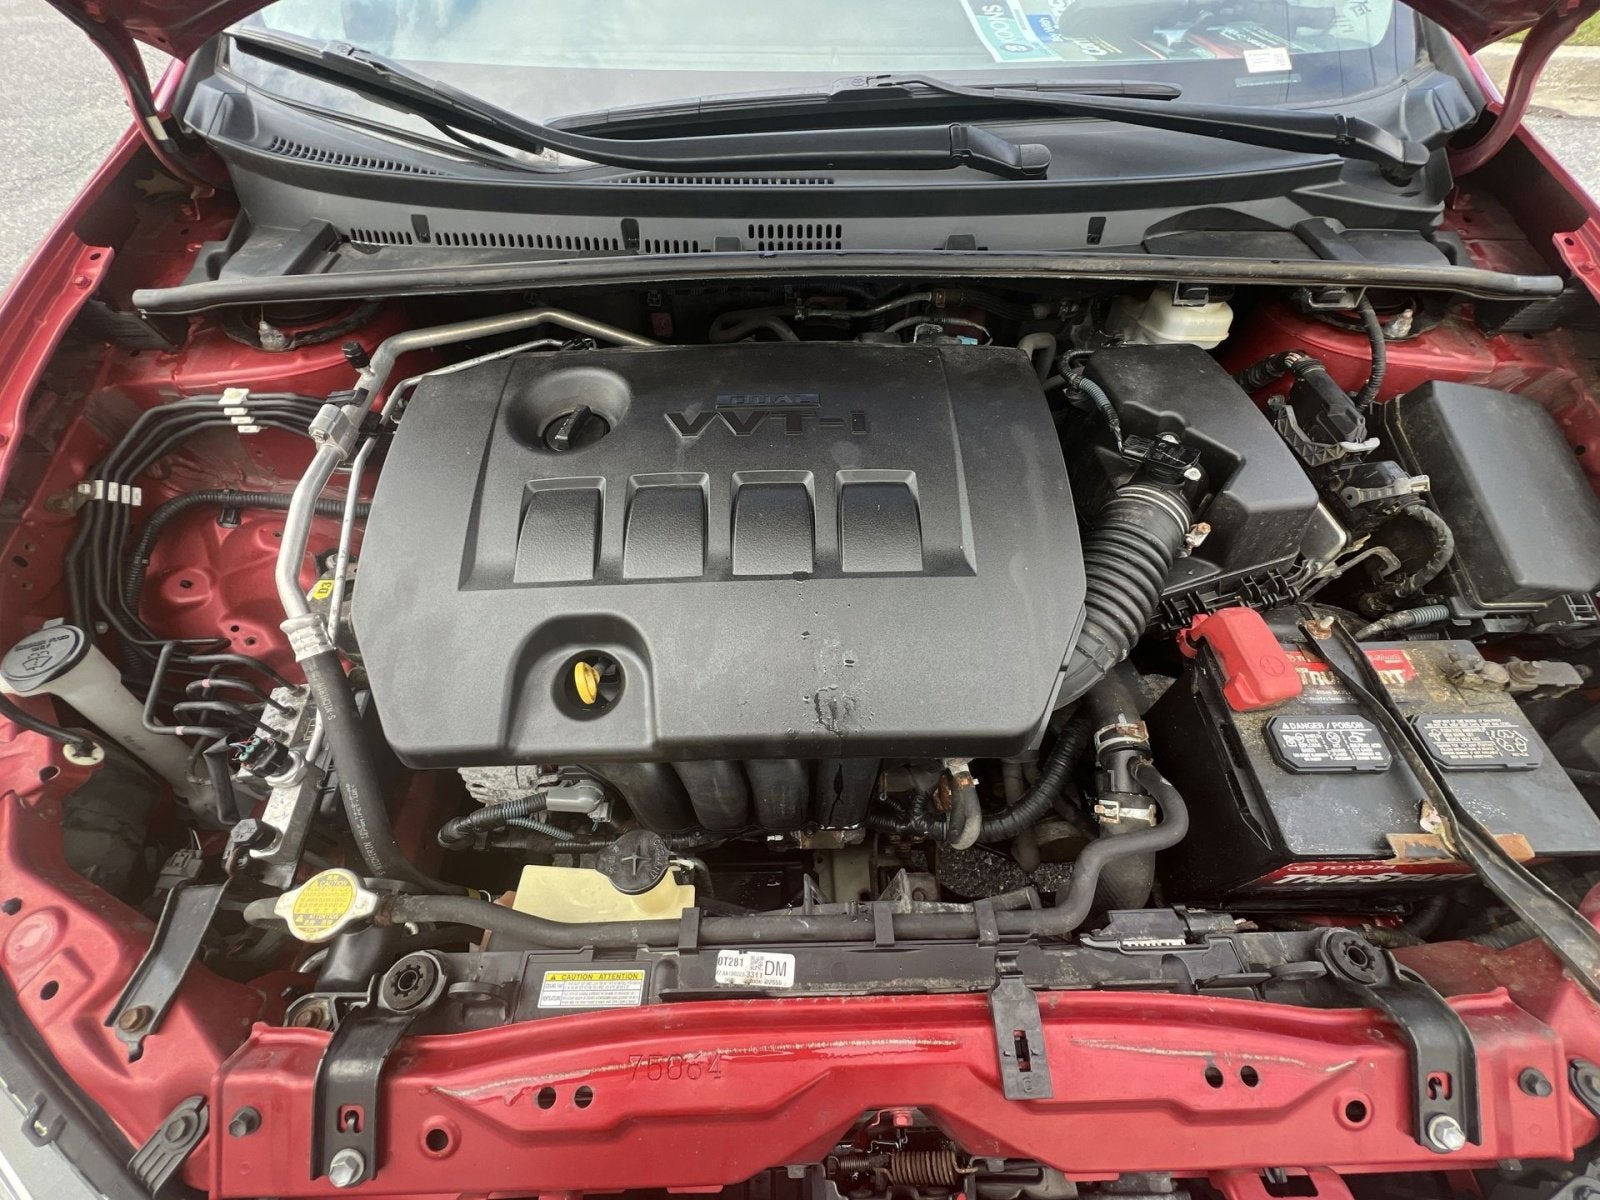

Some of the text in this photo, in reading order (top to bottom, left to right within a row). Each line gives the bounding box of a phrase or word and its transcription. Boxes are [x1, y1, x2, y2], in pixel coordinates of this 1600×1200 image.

[1289, 722, 1325, 730] DANGER
[1331, 721, 1365, 730] POISON
[764, 960, 787, 976] DM
